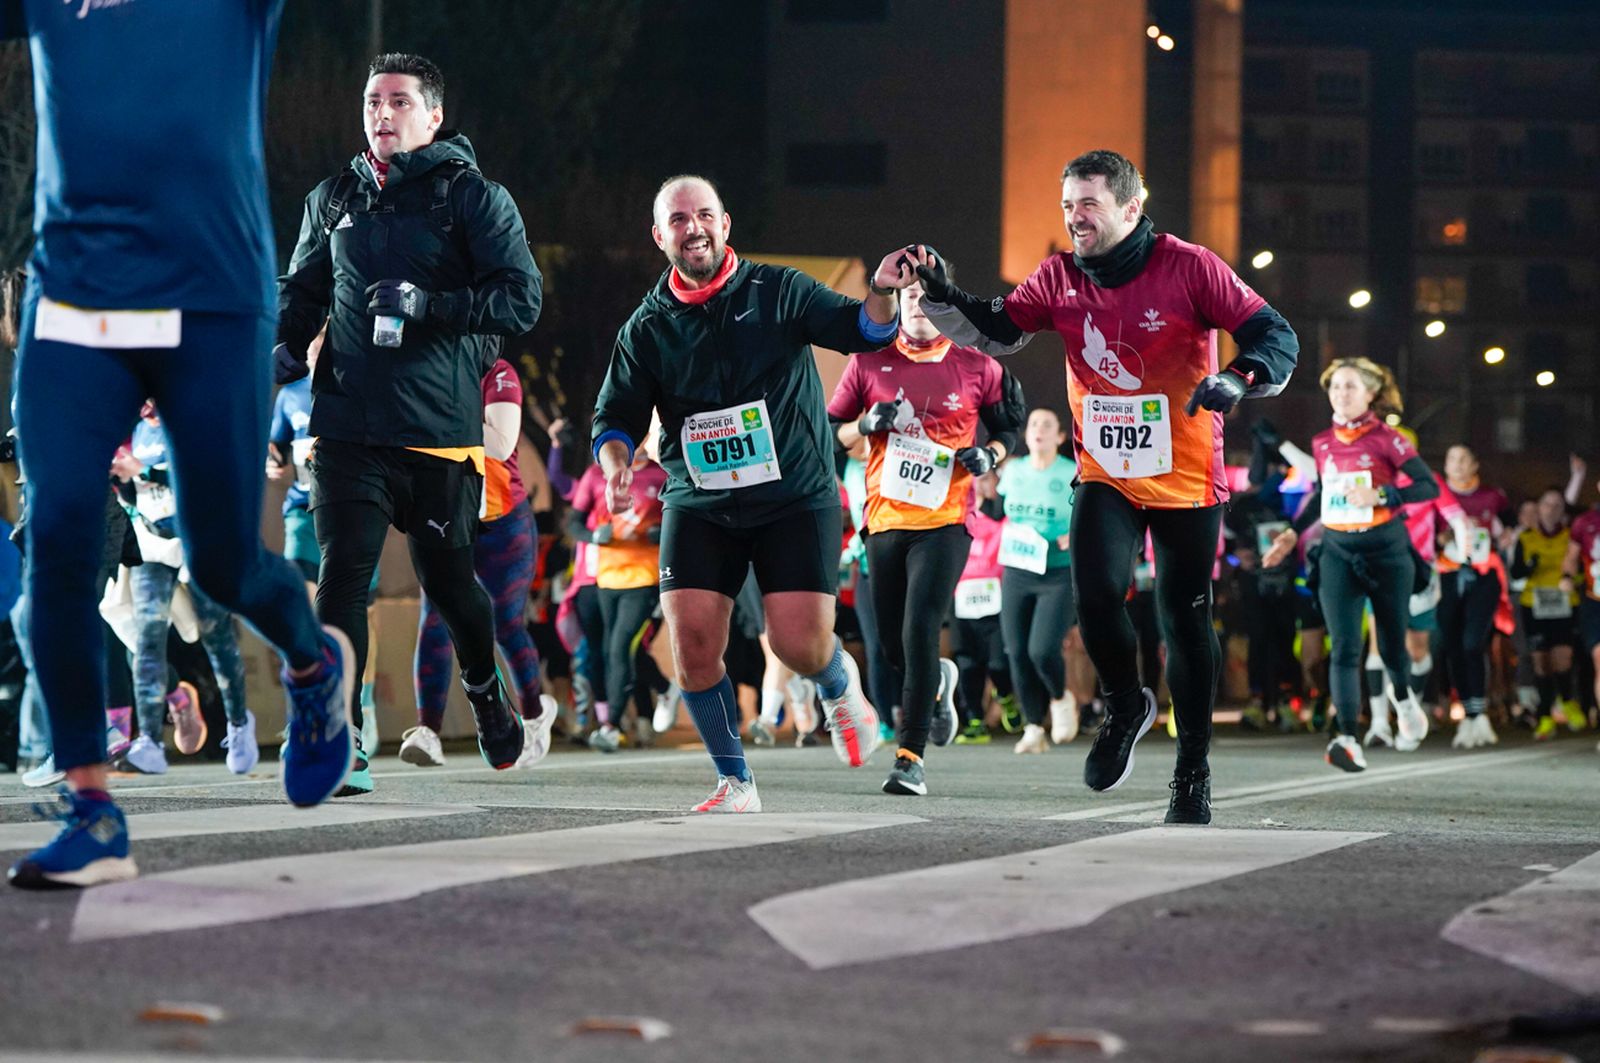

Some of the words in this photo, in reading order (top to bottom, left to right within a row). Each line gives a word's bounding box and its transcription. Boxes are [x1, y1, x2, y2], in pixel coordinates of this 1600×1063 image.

[1098, 357, 1119, 379] 43
[1102, 405, 1123, 414] NOCHE
[1124, 405, 1135, 414] DE
[697, 419, 725, 430] NOCHE
[725, 416, 734, 427] DE
[1092, 414, 1109, 423] SAN
[690, 432, 706, 441] SAN
[708, 427, 736, 439] ANTÓN
[904, 422, 921, 439] 43
[1099, 425, 1152, 450] 6792
[702, 433, 757, 464] 6791
[893, 448, 906, 458] SAN
[899, 460, 934, 485] 602
